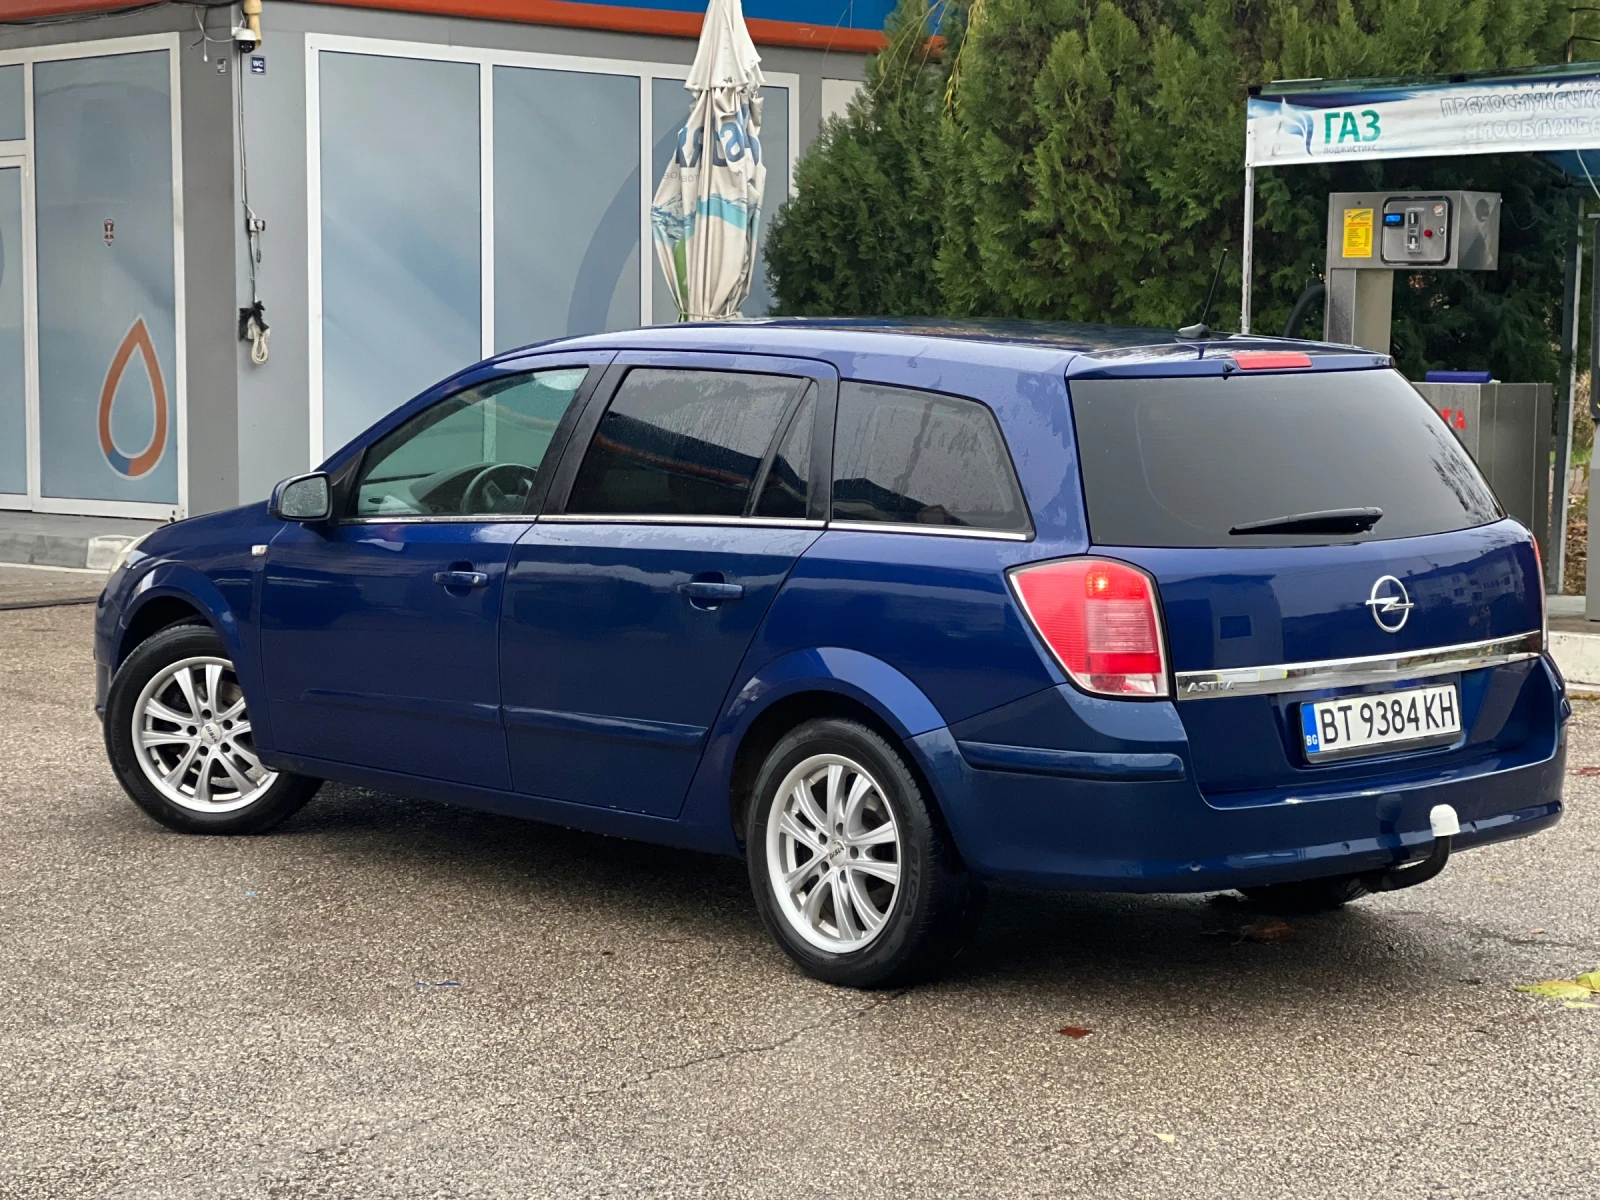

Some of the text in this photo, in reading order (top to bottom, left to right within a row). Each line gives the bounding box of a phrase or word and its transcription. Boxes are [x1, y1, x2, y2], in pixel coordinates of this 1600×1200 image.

[252, 60, 264, 68] WC
[1324, 109, 1381, 144] ГАЗ
[1186, 680, 1235, 693] ASTRA
[1320, 691, 1456, 744] BT 9384 KH
[1306, 735, 1318, 746] BG
